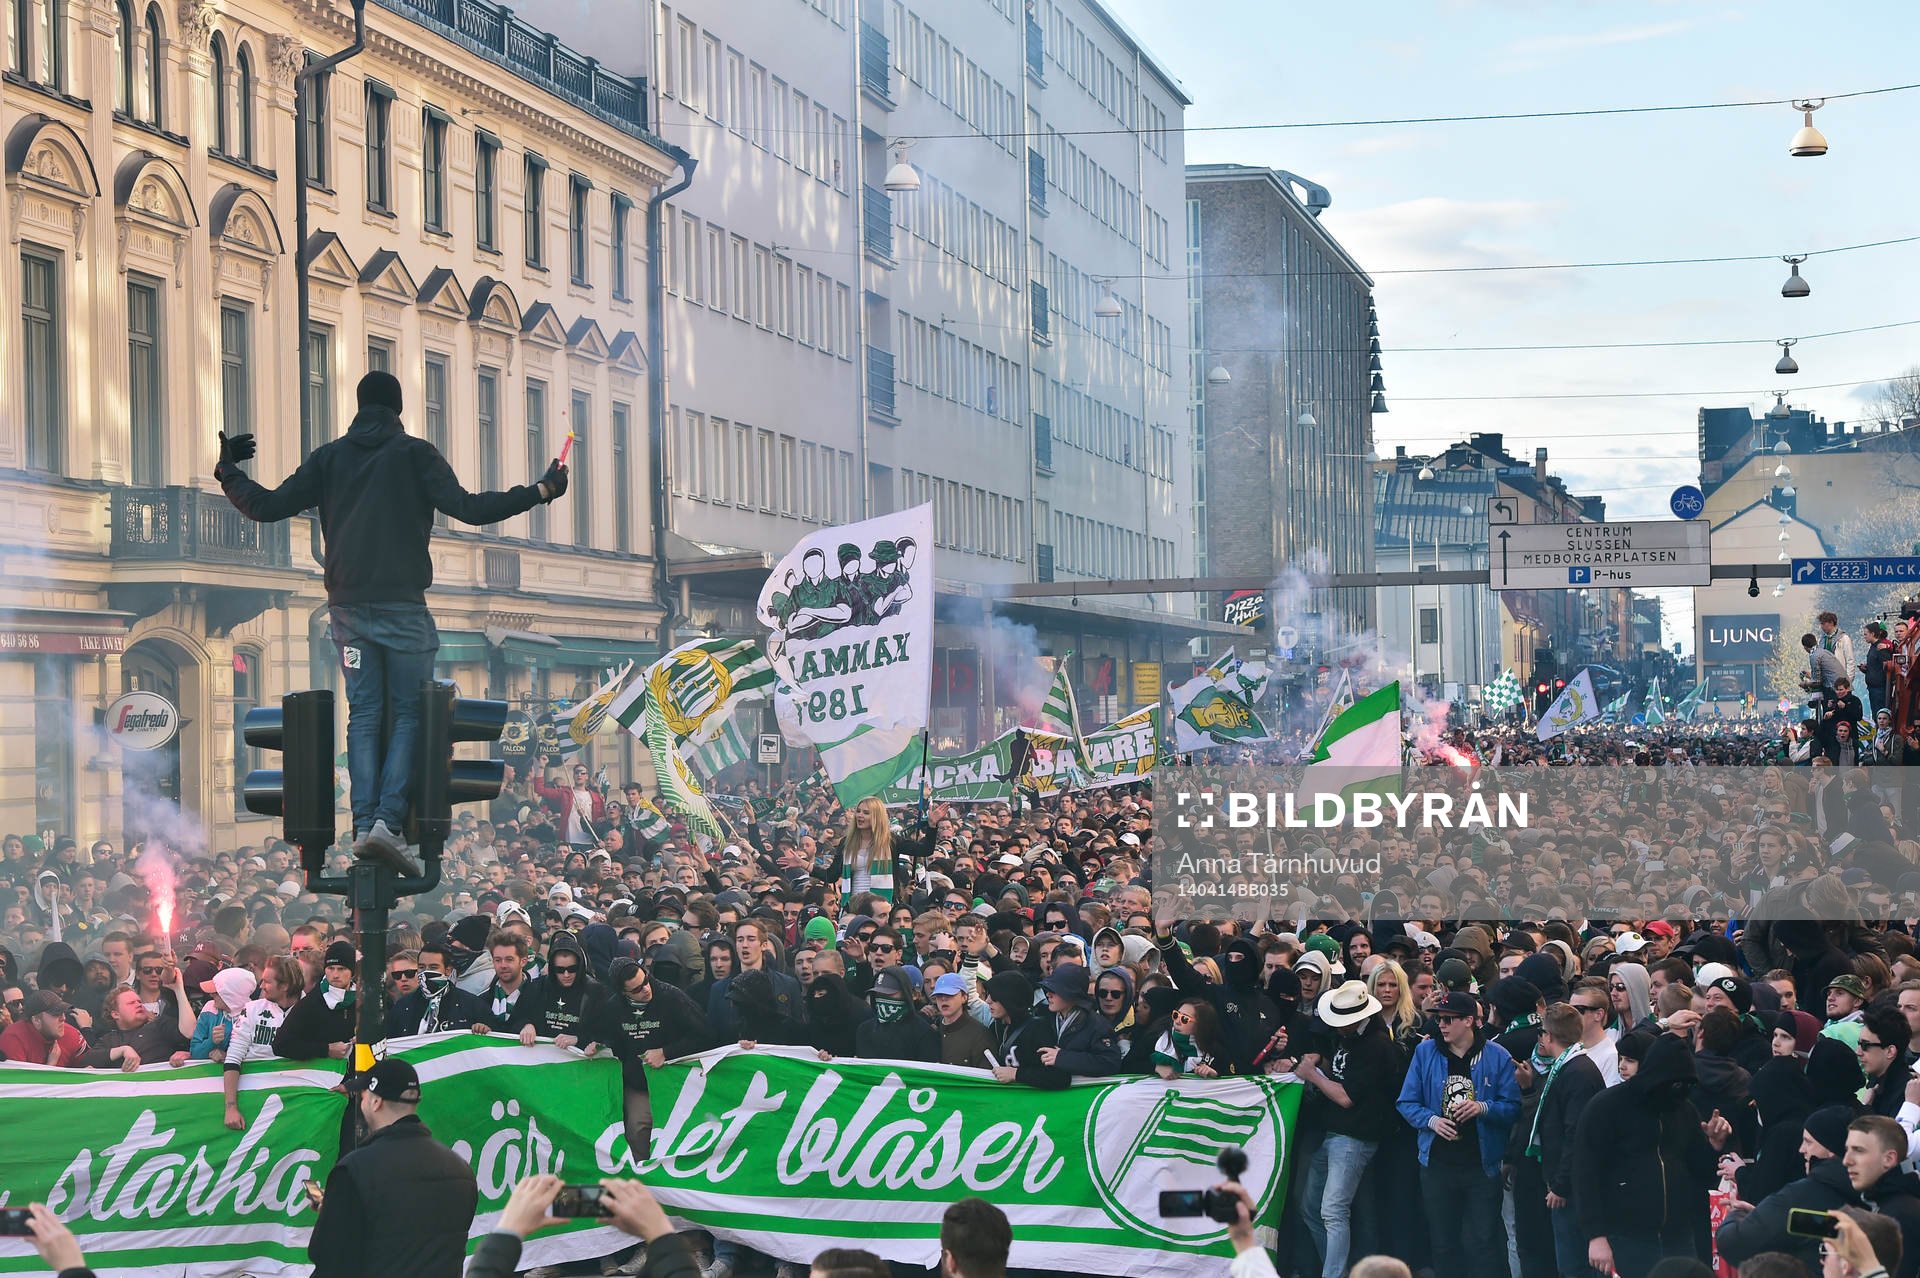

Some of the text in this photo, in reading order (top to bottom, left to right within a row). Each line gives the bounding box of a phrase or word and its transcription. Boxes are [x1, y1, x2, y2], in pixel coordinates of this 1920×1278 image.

[1566, 526, 1632, 537] CENTRUM
[1567, 539, 1631, 551] SLUSSEN
[1523, 551, 1677, 565] MEDBORGARPLATSEN
[1575, 569, 1632, 581] P P-hus
[1830, 564, 1920, 577] 222 NACK
[1224, 595, 1264, 622] Pizza
[1232, 605, 1261, 626] Hut
[0, 635, 124, 651] 640 56 86 TAKE AWAY
[1709, 627, 1774, 648] LJUNG
[112, 704, 169, 735] Segafredo
[1030, 727, 1157, 777] BAARE
[253, 1019, 279, 1046] SÖDE
[45, 1093, 321, 1224] starka
[594, 1066, 788, 1184] det
[776, 1068, 1065, 1194] blåser
